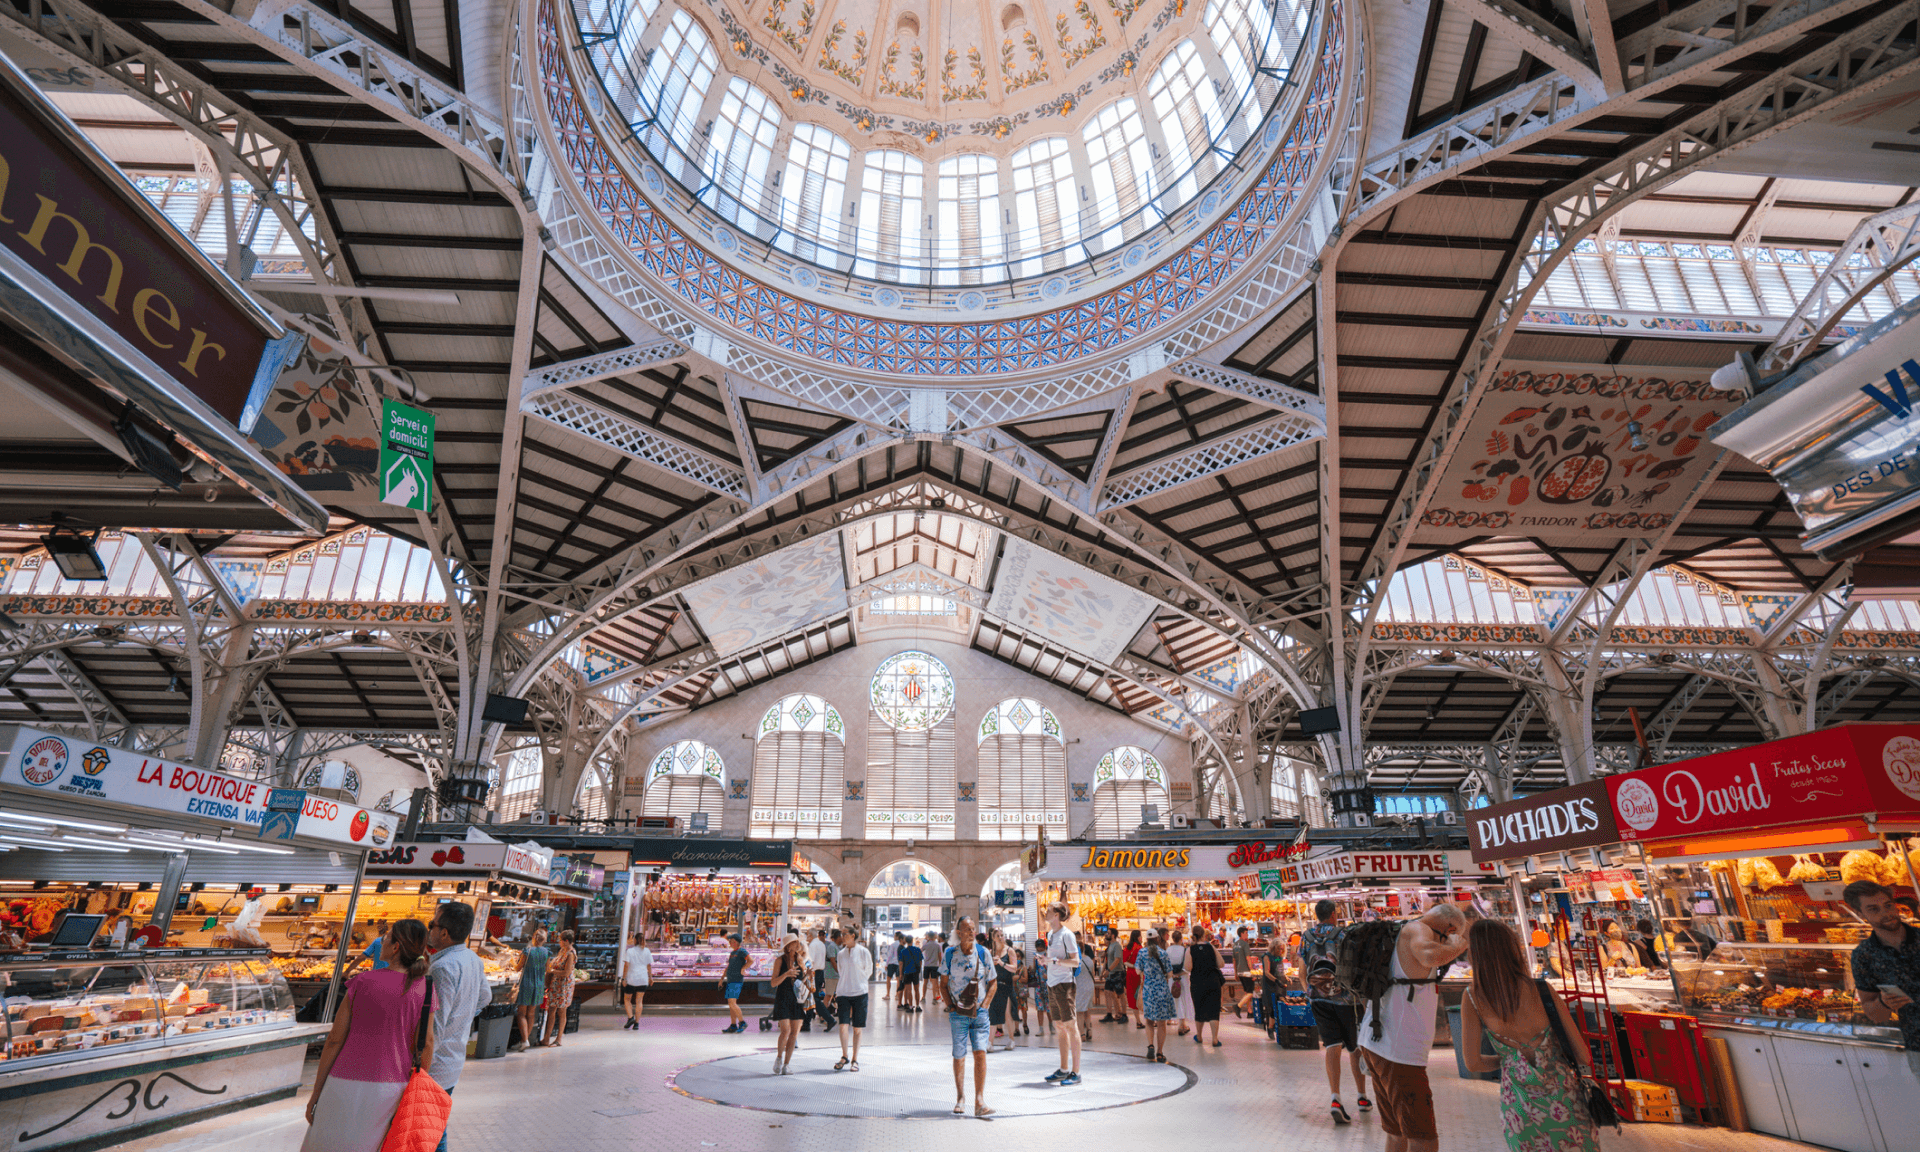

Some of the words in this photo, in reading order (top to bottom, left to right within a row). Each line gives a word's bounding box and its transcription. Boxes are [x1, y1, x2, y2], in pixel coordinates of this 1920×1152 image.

[390, 409, 421, 432] Servei
[422, 424, 428, 434] a
[389, 426, 428, 449] domicili
[1832, 470, 1874, 499] DES
[1876, 453, 1909, 478] DE
[1519, 516, 1578, 527] TARDOR
[29, 739, 66, 760] BOUTIQUE
[24, 767, 53, 783] QUESO
[1771, 759, 1812, 778] Frutos
[1811, 754, 1847, 771] Secos
[137, 759, 162, 786] LA
[169, 766, 257, 805] BOUTIQUE
[1663, 762, 1771, 824] David
[187, 797, 238, 820] EXTENSA
[1622, 797, 1655, 818] David
[1476, 797, 1599, 849] PUCHADES
[368, 845, 418, 864] ESAS
[1081, 846, 1191, 868] Jamones
[1353, 854, 1444, 873] FRUTAS
[1301, 855, 1352, 880] FRUTAS
